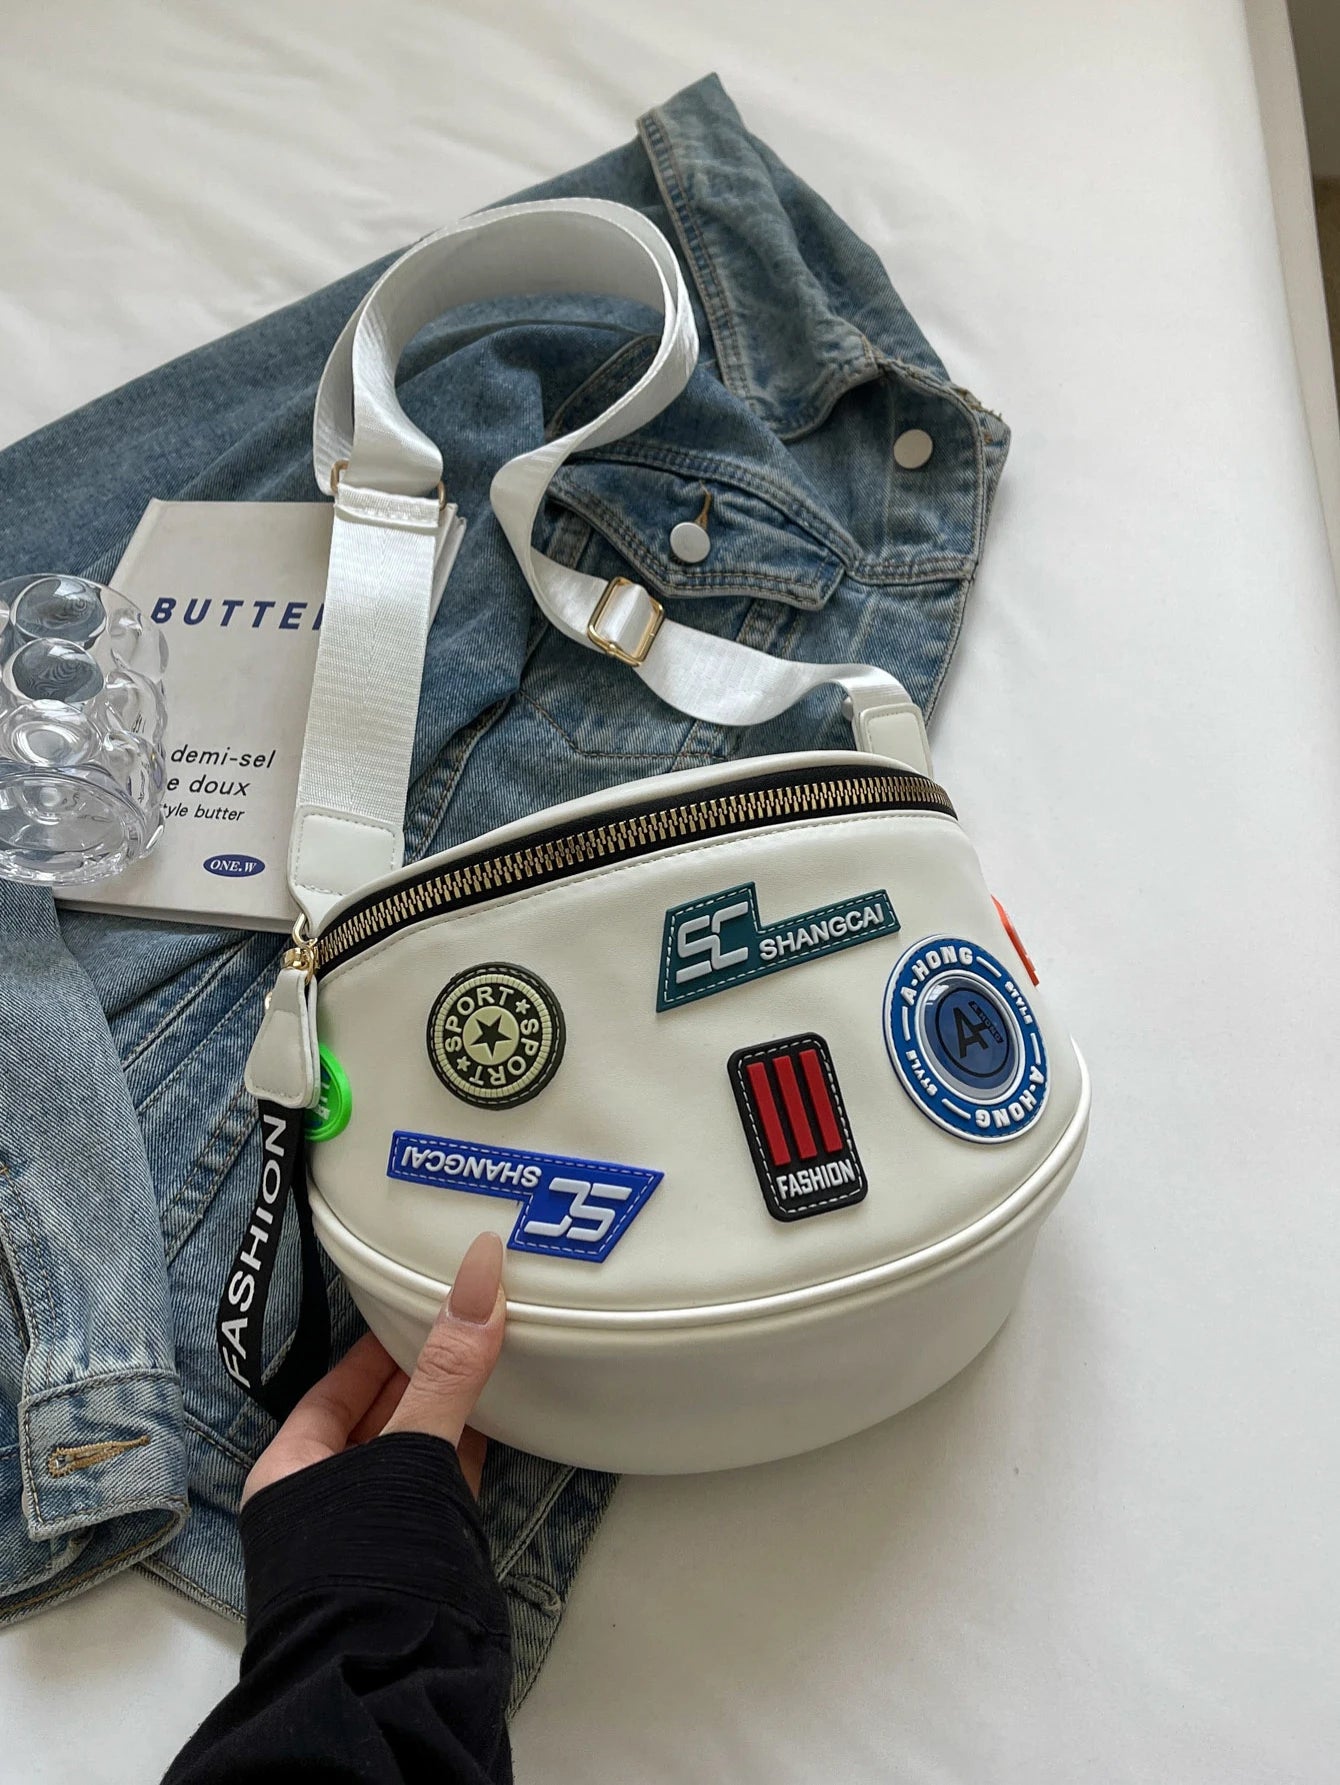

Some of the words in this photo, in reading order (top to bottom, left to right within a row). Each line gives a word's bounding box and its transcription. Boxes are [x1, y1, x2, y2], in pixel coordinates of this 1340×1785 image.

[170, 744, 277, 769] demi-sel
[189, 774, 251, 796] doux
[194, 804, 246, 821] butter
[210, 859, 257, 873] ONE.W
[758, 903, 885, 961] SHANGCAI
[445, 986, 514, 1053] SPORT
[1004, 980, 1033, 1025] STYLE
[468, 1018, 540, 1086] SPORT
[905, 1049, 938, 1097] STYLE
[401, 1146, 542, 1188] SHANGCAI
[775, 1158, 856, 1200] FASHION
[221, 1113, 287, 1389] FASHION
